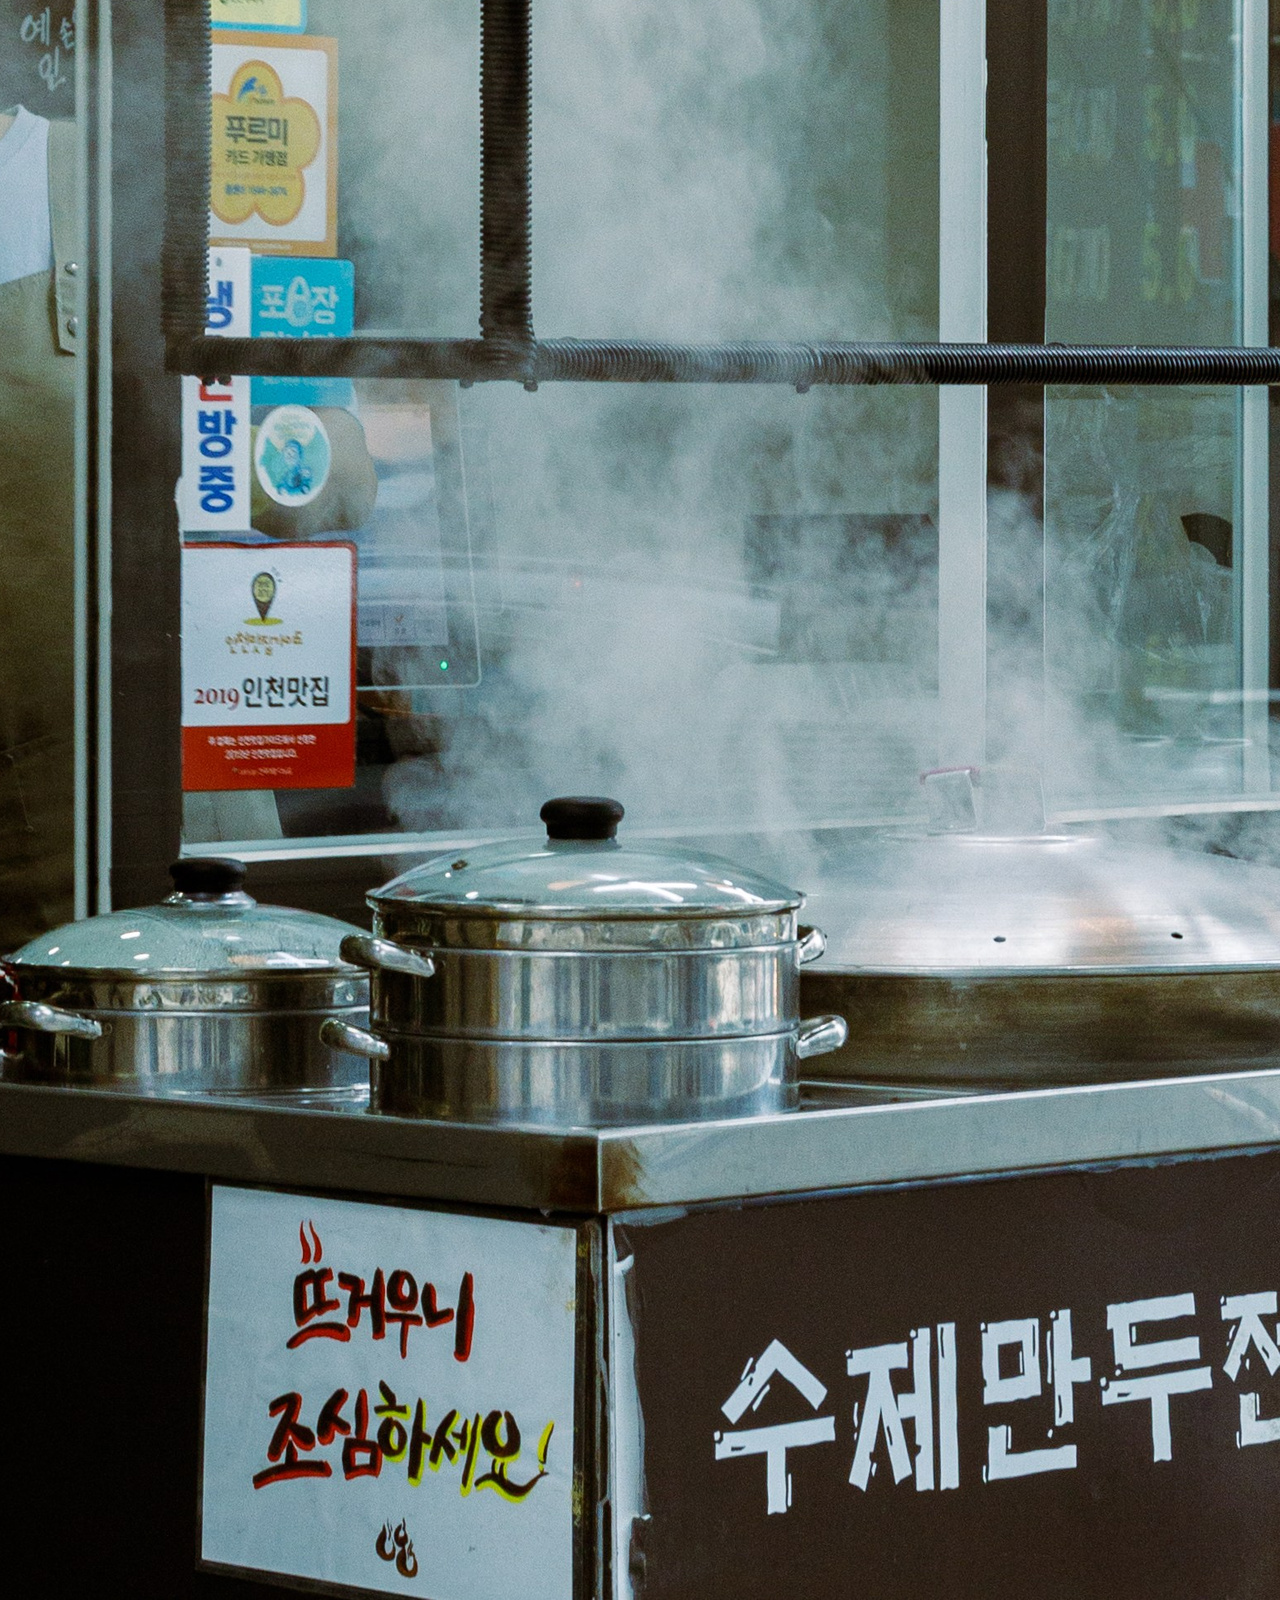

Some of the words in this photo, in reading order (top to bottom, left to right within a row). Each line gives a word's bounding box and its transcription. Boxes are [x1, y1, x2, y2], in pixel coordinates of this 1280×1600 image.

[226, 114, 289, 146] 푸르미
[226, 149, 250, 165] 카드
[253, 150, 288, 167] 가맹점
[194, 687, 240, 711] 2019
[243, 676, 330, 708] 인천맛집
[287, 1267, 475, 1362] 뜨거우니
